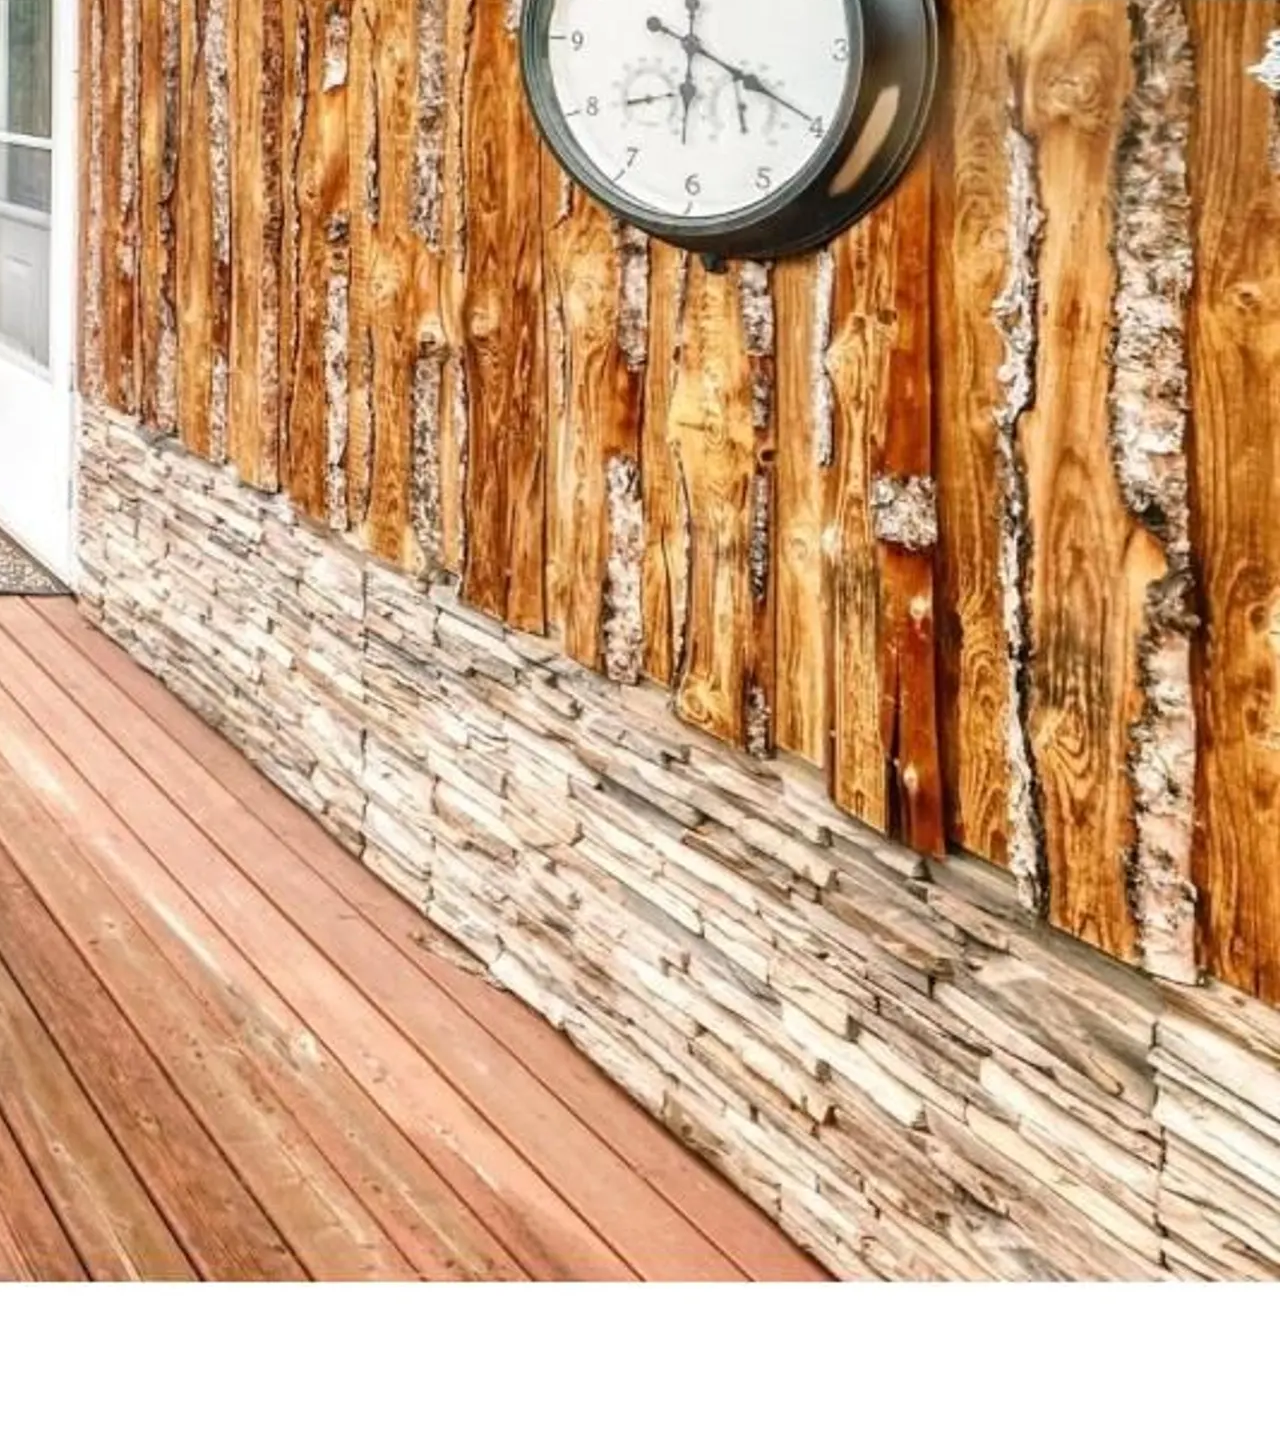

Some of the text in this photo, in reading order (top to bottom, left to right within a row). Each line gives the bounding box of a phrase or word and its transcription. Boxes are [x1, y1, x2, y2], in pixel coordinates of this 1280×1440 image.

[570, 29, 585, 50] 9
[832, 38, 849, 63] 3
[585, 95, 600, 117] 8
[808, 115, 827, 141] 4
[626, 146, 641, 168] 7
[684, 173, 701, 197] 6
[754, 166, 772, 190] 5
